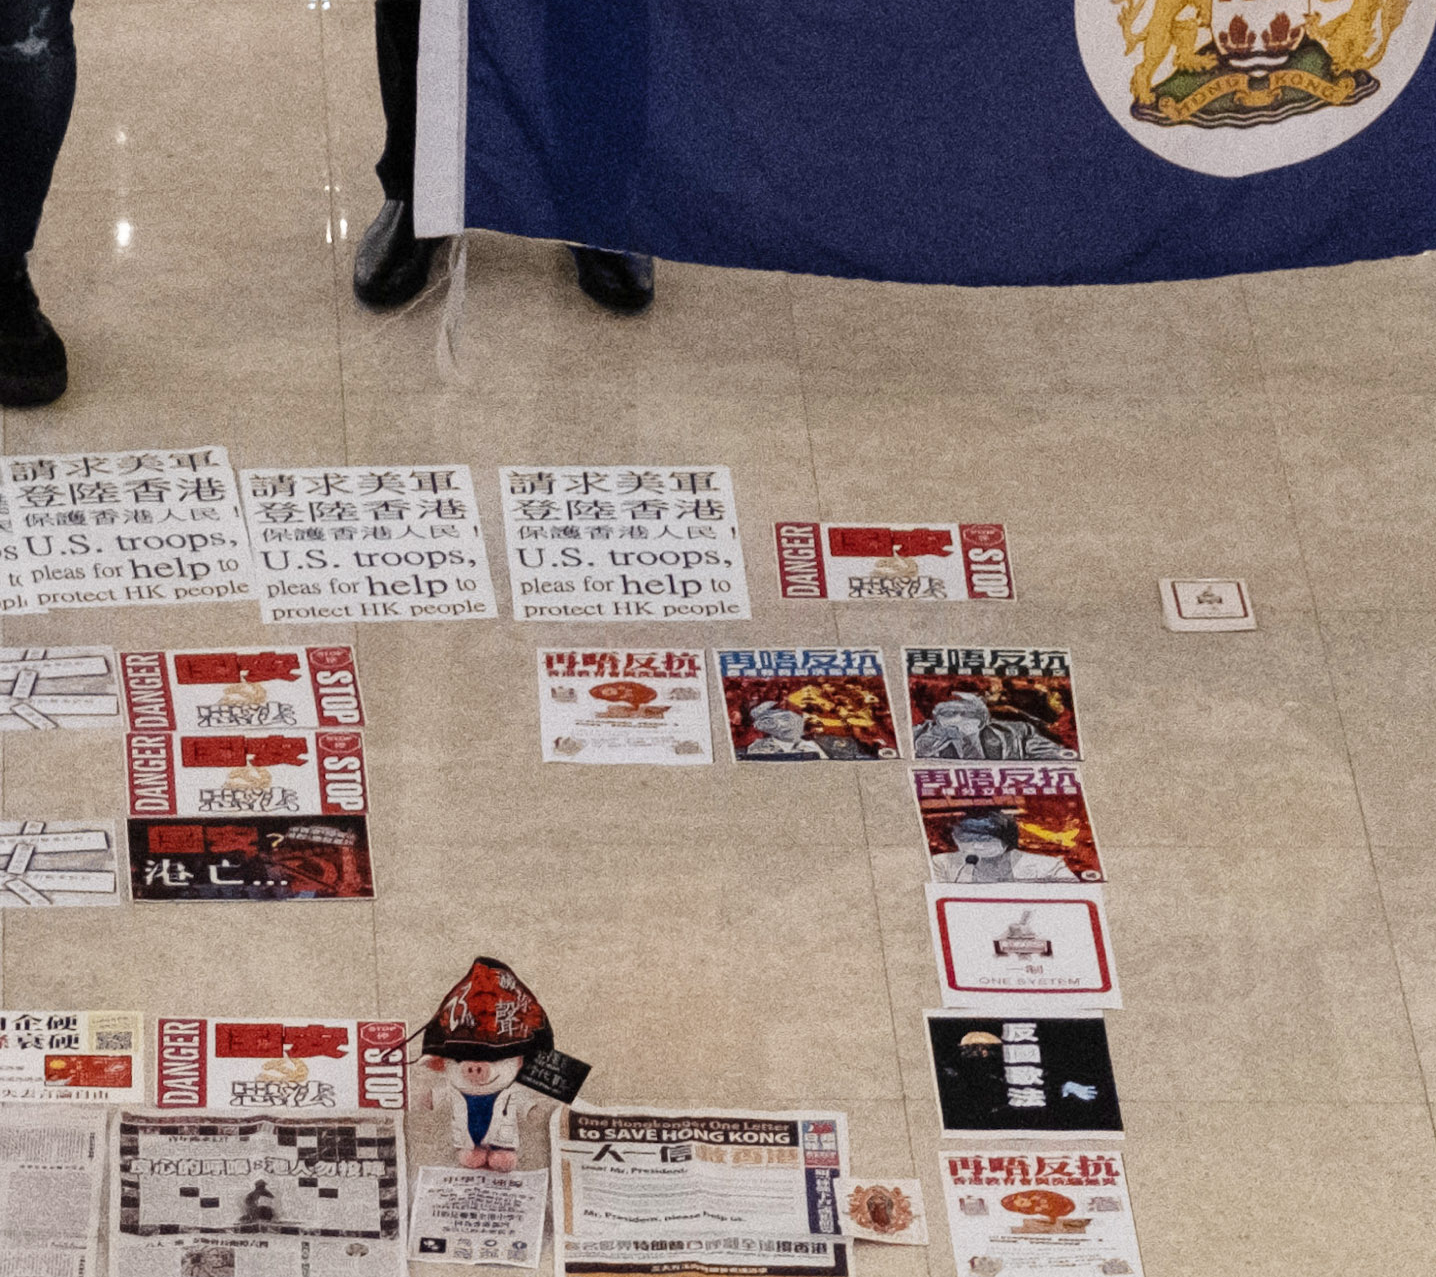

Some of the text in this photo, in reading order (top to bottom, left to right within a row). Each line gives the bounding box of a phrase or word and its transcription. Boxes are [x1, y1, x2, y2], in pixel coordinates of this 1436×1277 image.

[1276, 74, 1335, 101] KONG
[11, 451, 221, 481] 請求美軍
[18, 479, 225, 508] 登陸香港
[250, 471, 460, 498] 請求美軍
[508, 471, 719, 496] 請求美軍
[255, 498, 467, 524] 登陸香港
[513, 498, 726, 523] 登陸香港
[27, 531, 237, 557] U.S. troops,
[517, 546, 732, 568] U.S. troops,
[32, 557, 239, 584] pleas for help to
[262, 548, 476, 572] U.S. troops,
[780, 526, 821, 597] DANGER
[969, 548, 1010, 598] STOP
[38, 581, 248, 606] protect HK people
[268, 575, 476, 598] pleas for help to
[520, 574, 731, 596] pleas for help to
[272, 599, 486, 621] protect HK people
[525, 599, 740, 619] protect HK people
[125, 654, 169, 728] DANGER
[316, 670, 361, 723] STOP
[131, 736, 170, 811] DANGER
[323, 757, 364, 811] STOP
[162, 1022, 200, 1104] DANGER
[364, 1048, 405, 1109] STOP
[578, 1128, 790, 1145] to SAVE HONG KONG
